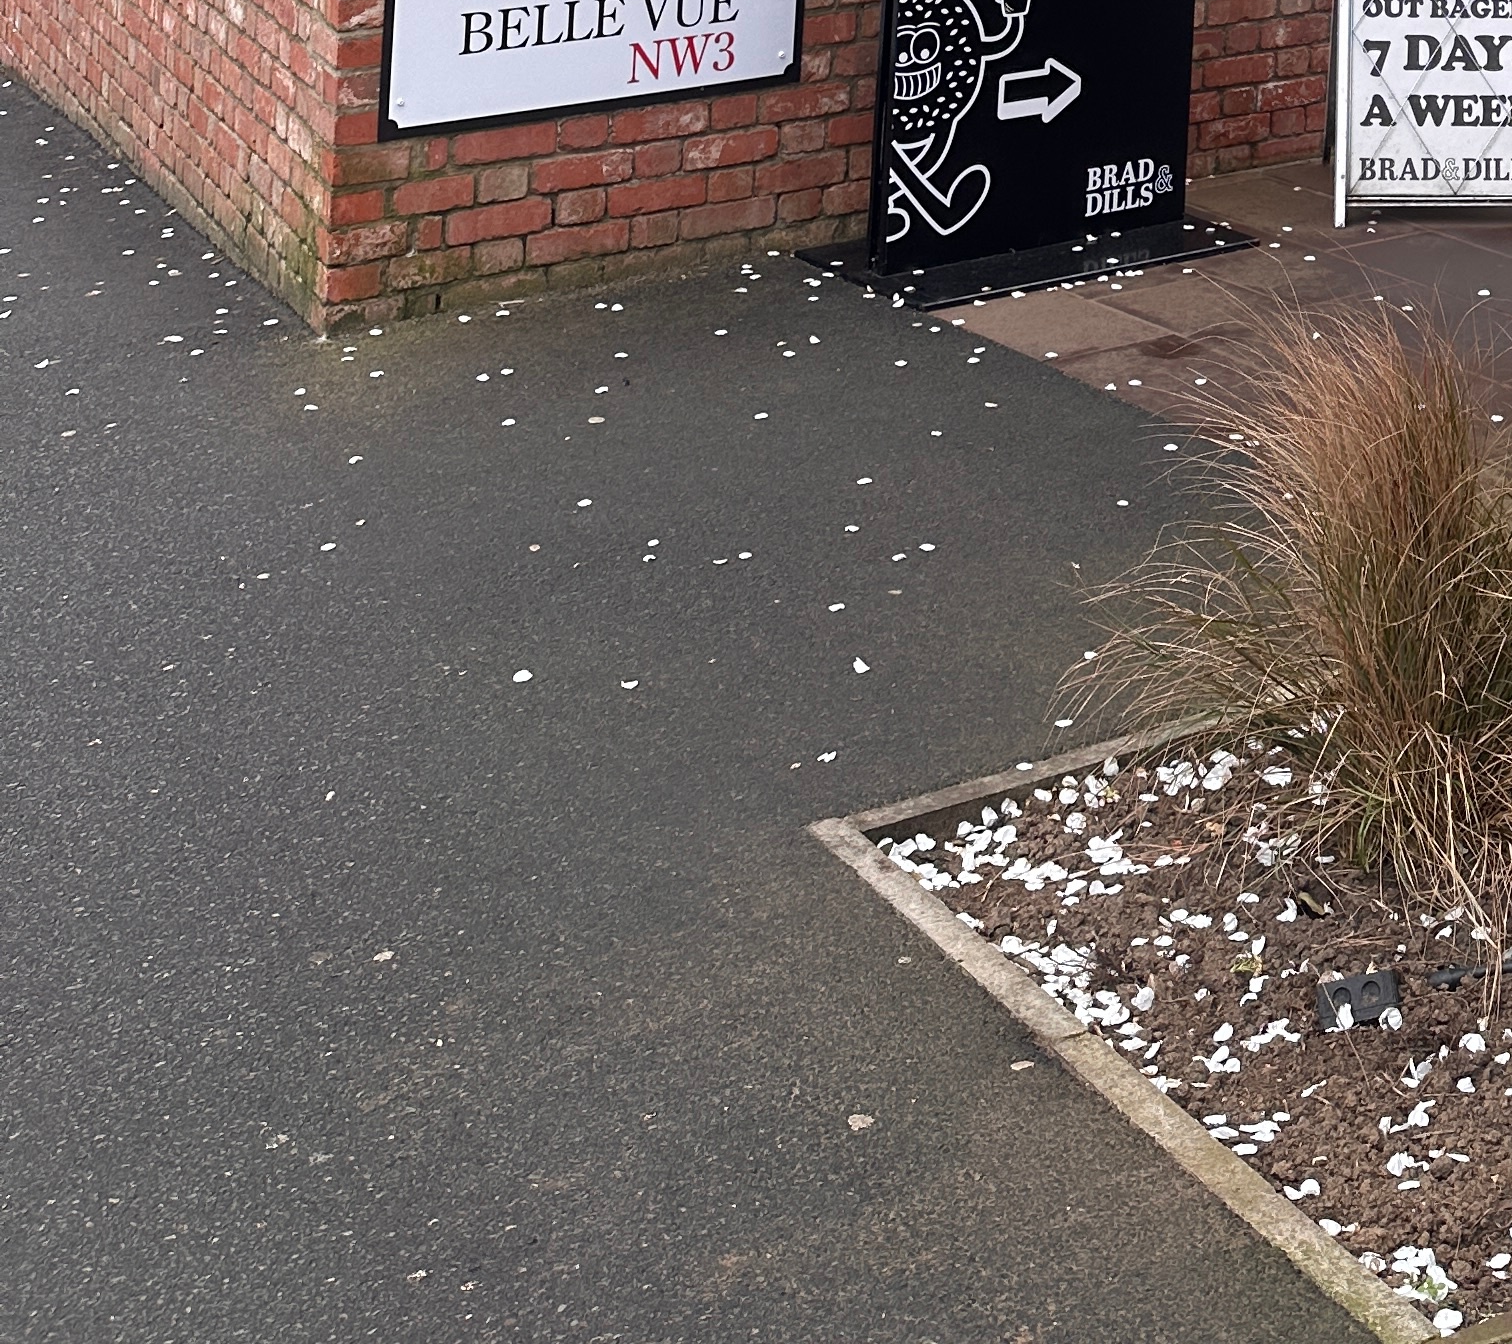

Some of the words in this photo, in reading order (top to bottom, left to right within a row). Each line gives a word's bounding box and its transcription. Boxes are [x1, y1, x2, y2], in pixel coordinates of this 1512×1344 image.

[626, 31, 736, 85] NW3
[1362, 39, 1392, 78] 7
[1359, 93, 1398, 127] A
[1085, 158, 1155, 192] BRAD
[1154, 164, 1174, 194] &
[1084, 182, 1154, 218] DILLS
